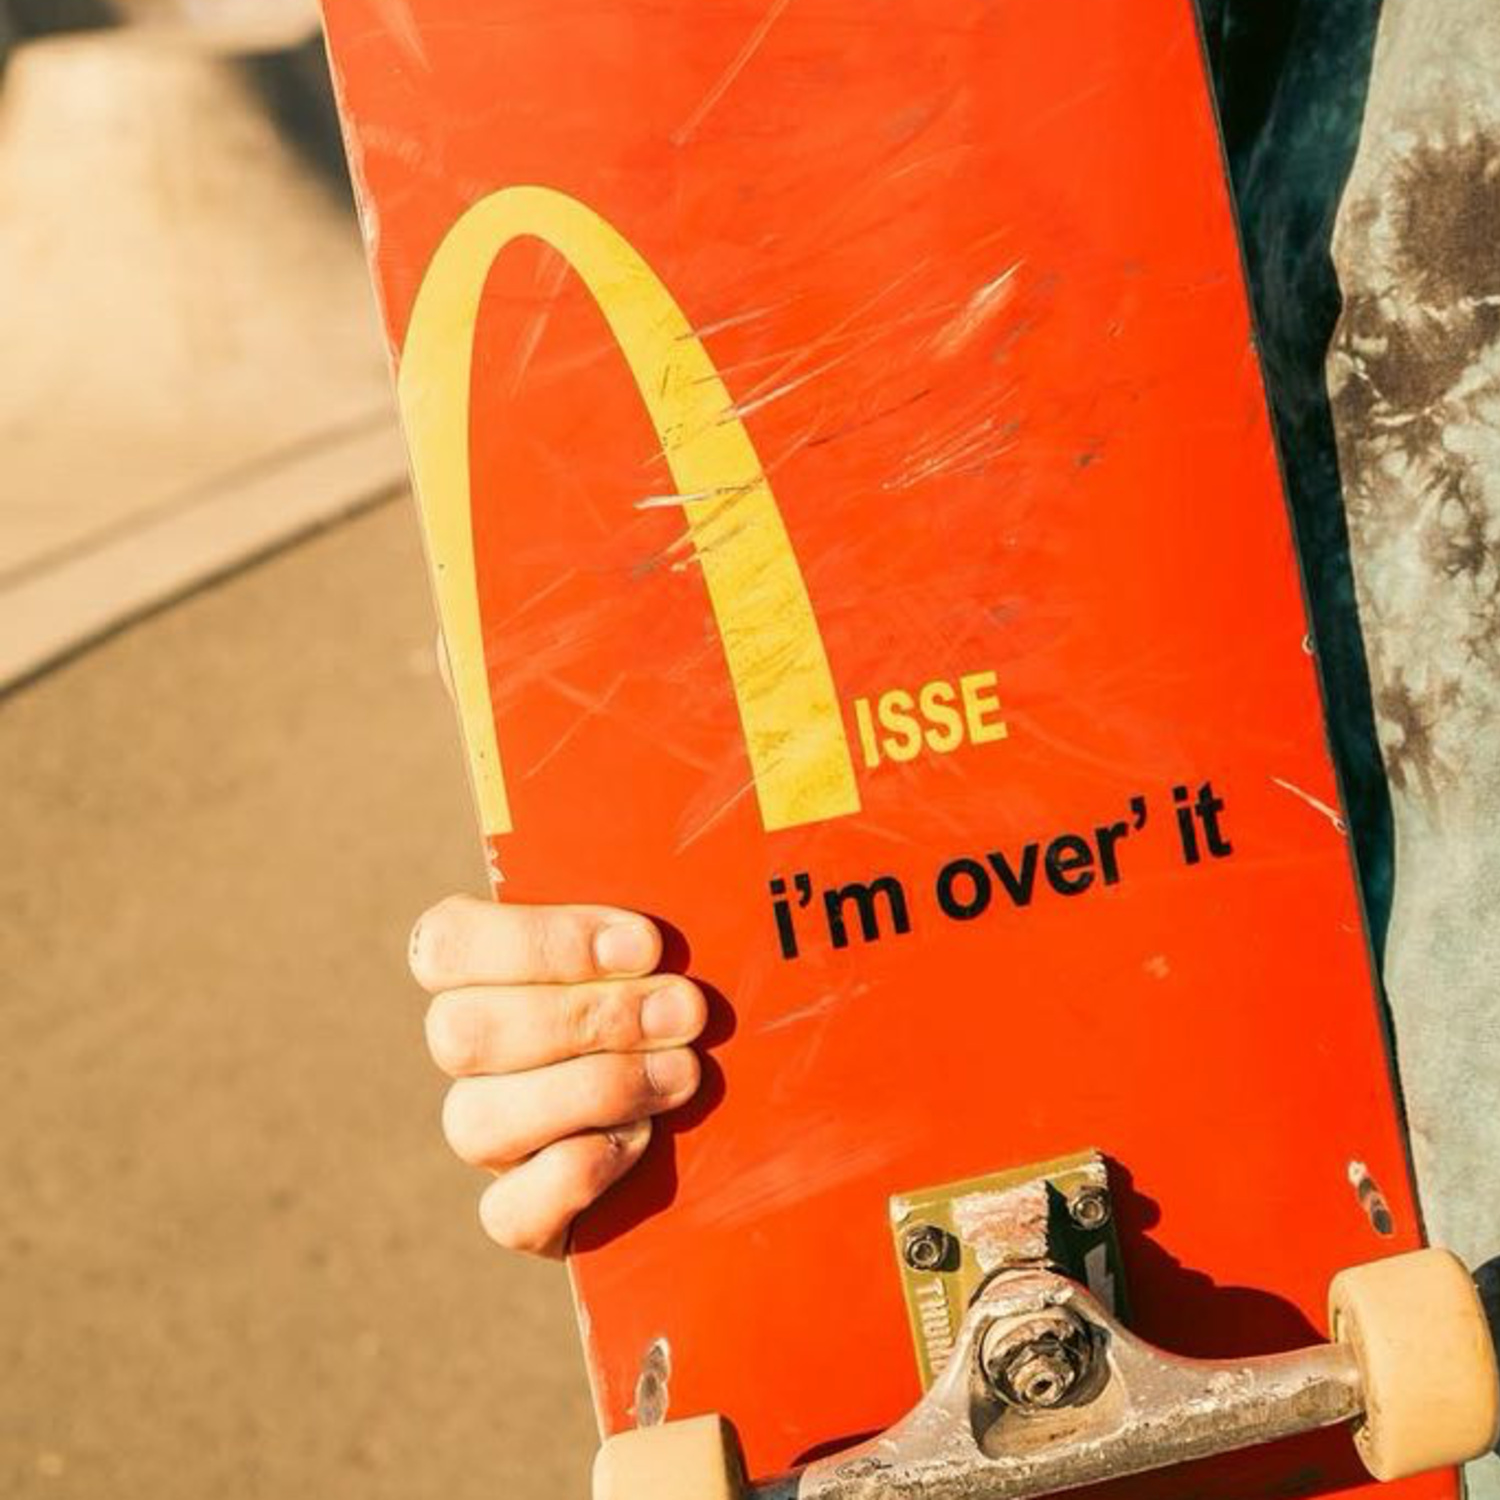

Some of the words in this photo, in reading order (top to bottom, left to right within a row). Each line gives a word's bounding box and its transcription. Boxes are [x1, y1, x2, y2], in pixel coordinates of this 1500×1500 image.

[769, 872, 910, 959] i'm
[935, 796, 1147, 921] over'
[1172, 783, 1232, 865] it
